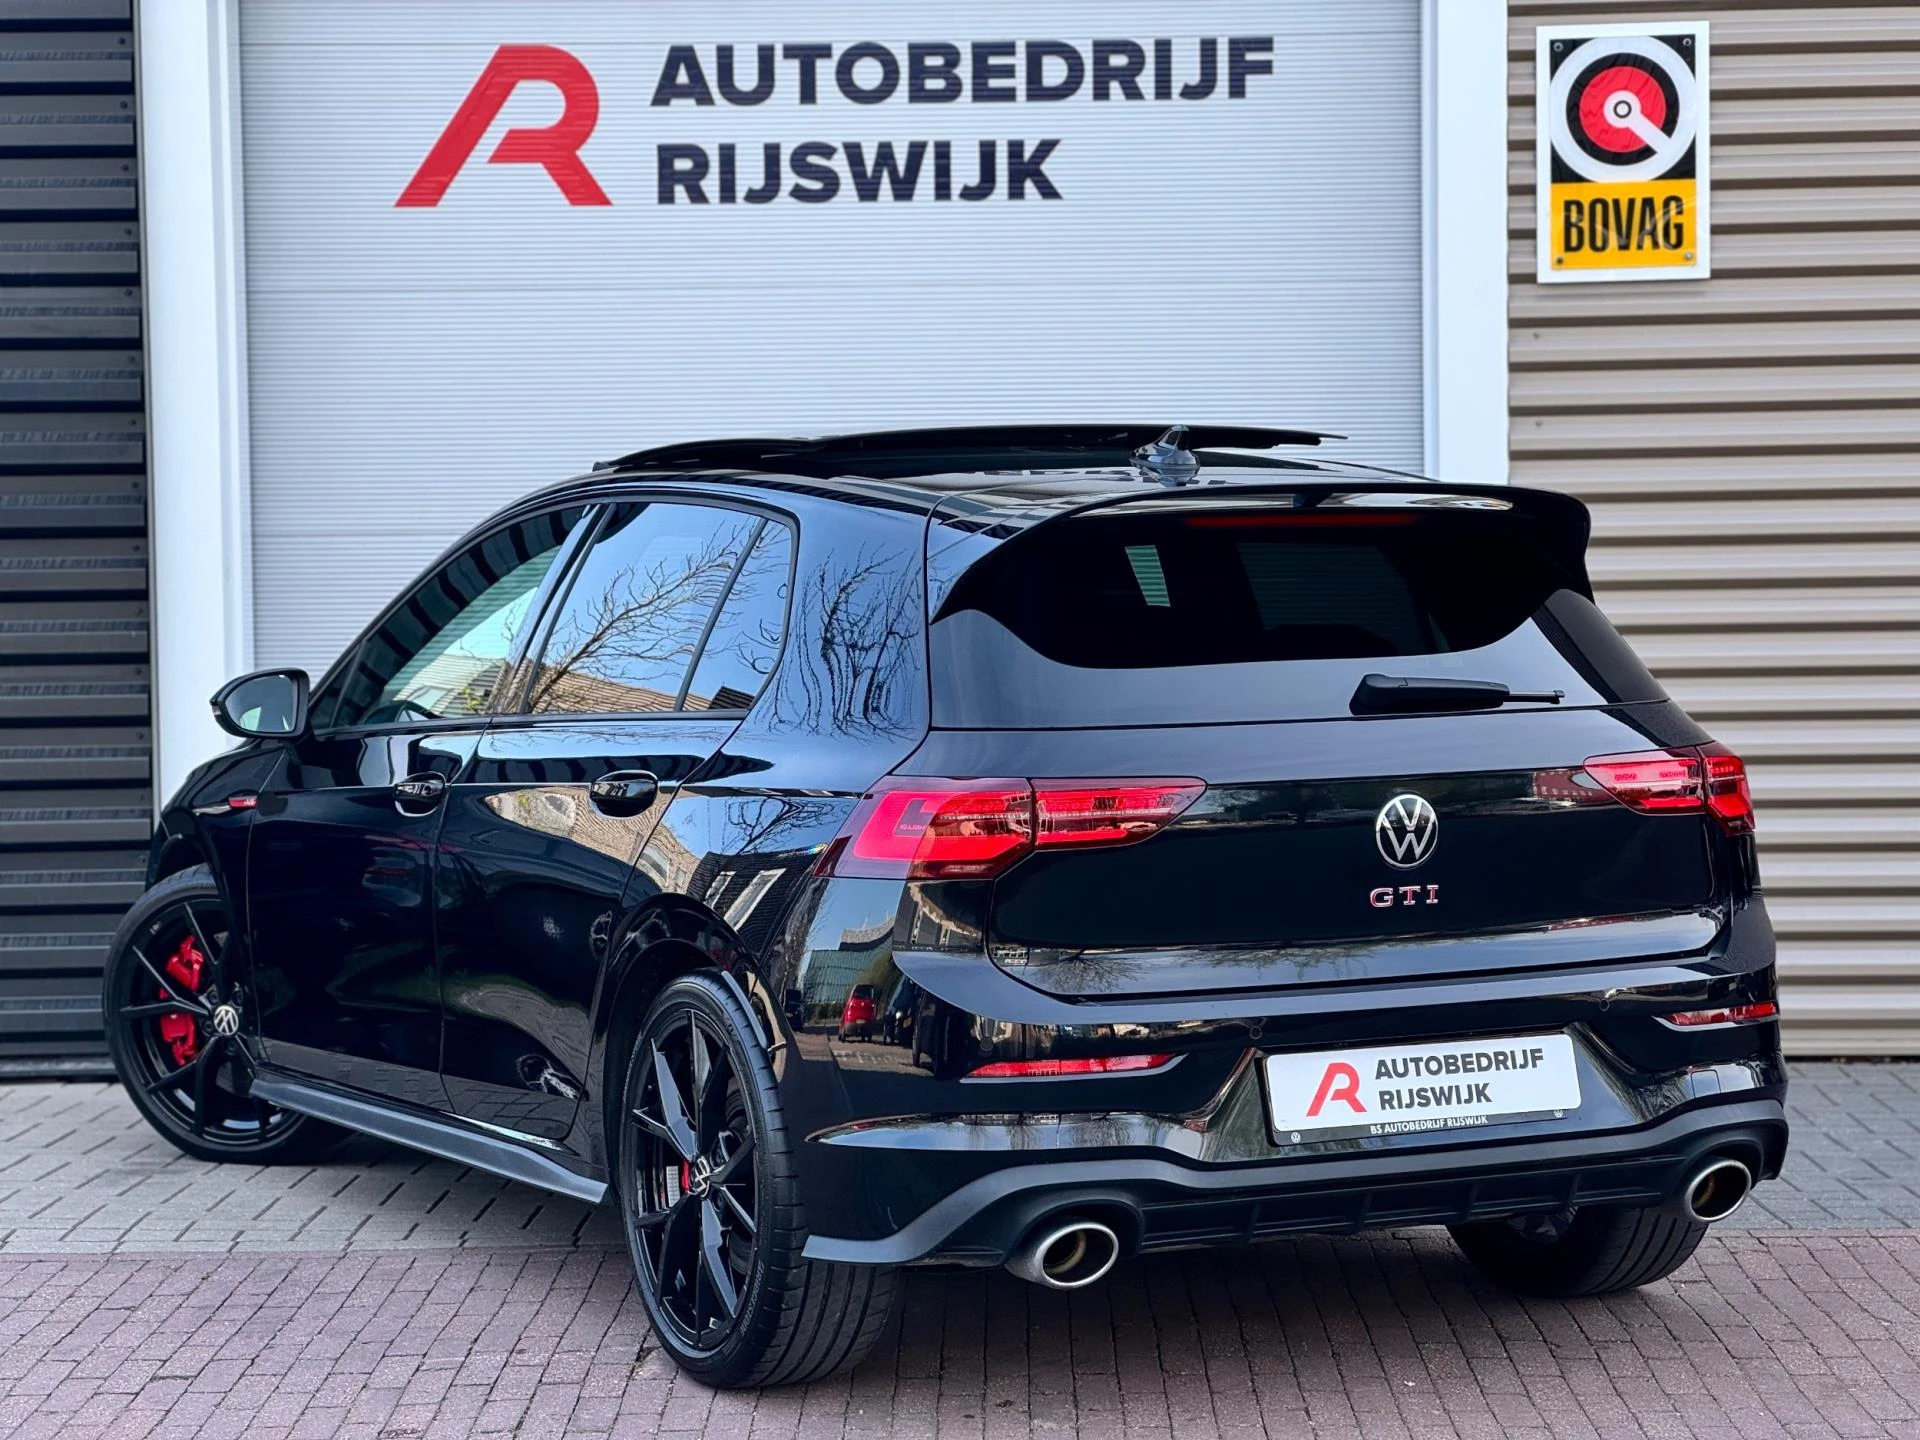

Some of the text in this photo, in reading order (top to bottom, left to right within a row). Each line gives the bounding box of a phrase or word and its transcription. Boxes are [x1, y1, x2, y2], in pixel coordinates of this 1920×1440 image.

[651, 36, 1274, 107] AUTOBEDRIJF
[657, 139, 1063, 205] RIJSWIJK
[1563, 195, 1684, 253] BOVAG
[1369, 884, 1440, 908] GTI
[1375, 1048, 1544, 1080] AUTOBEDRIJF
[1378, 1083, 1492, 1110] RIJSWIJK
[1370, 1115, 1488, 1135] BS AUTOBEDRIJF RIJSWIJK
